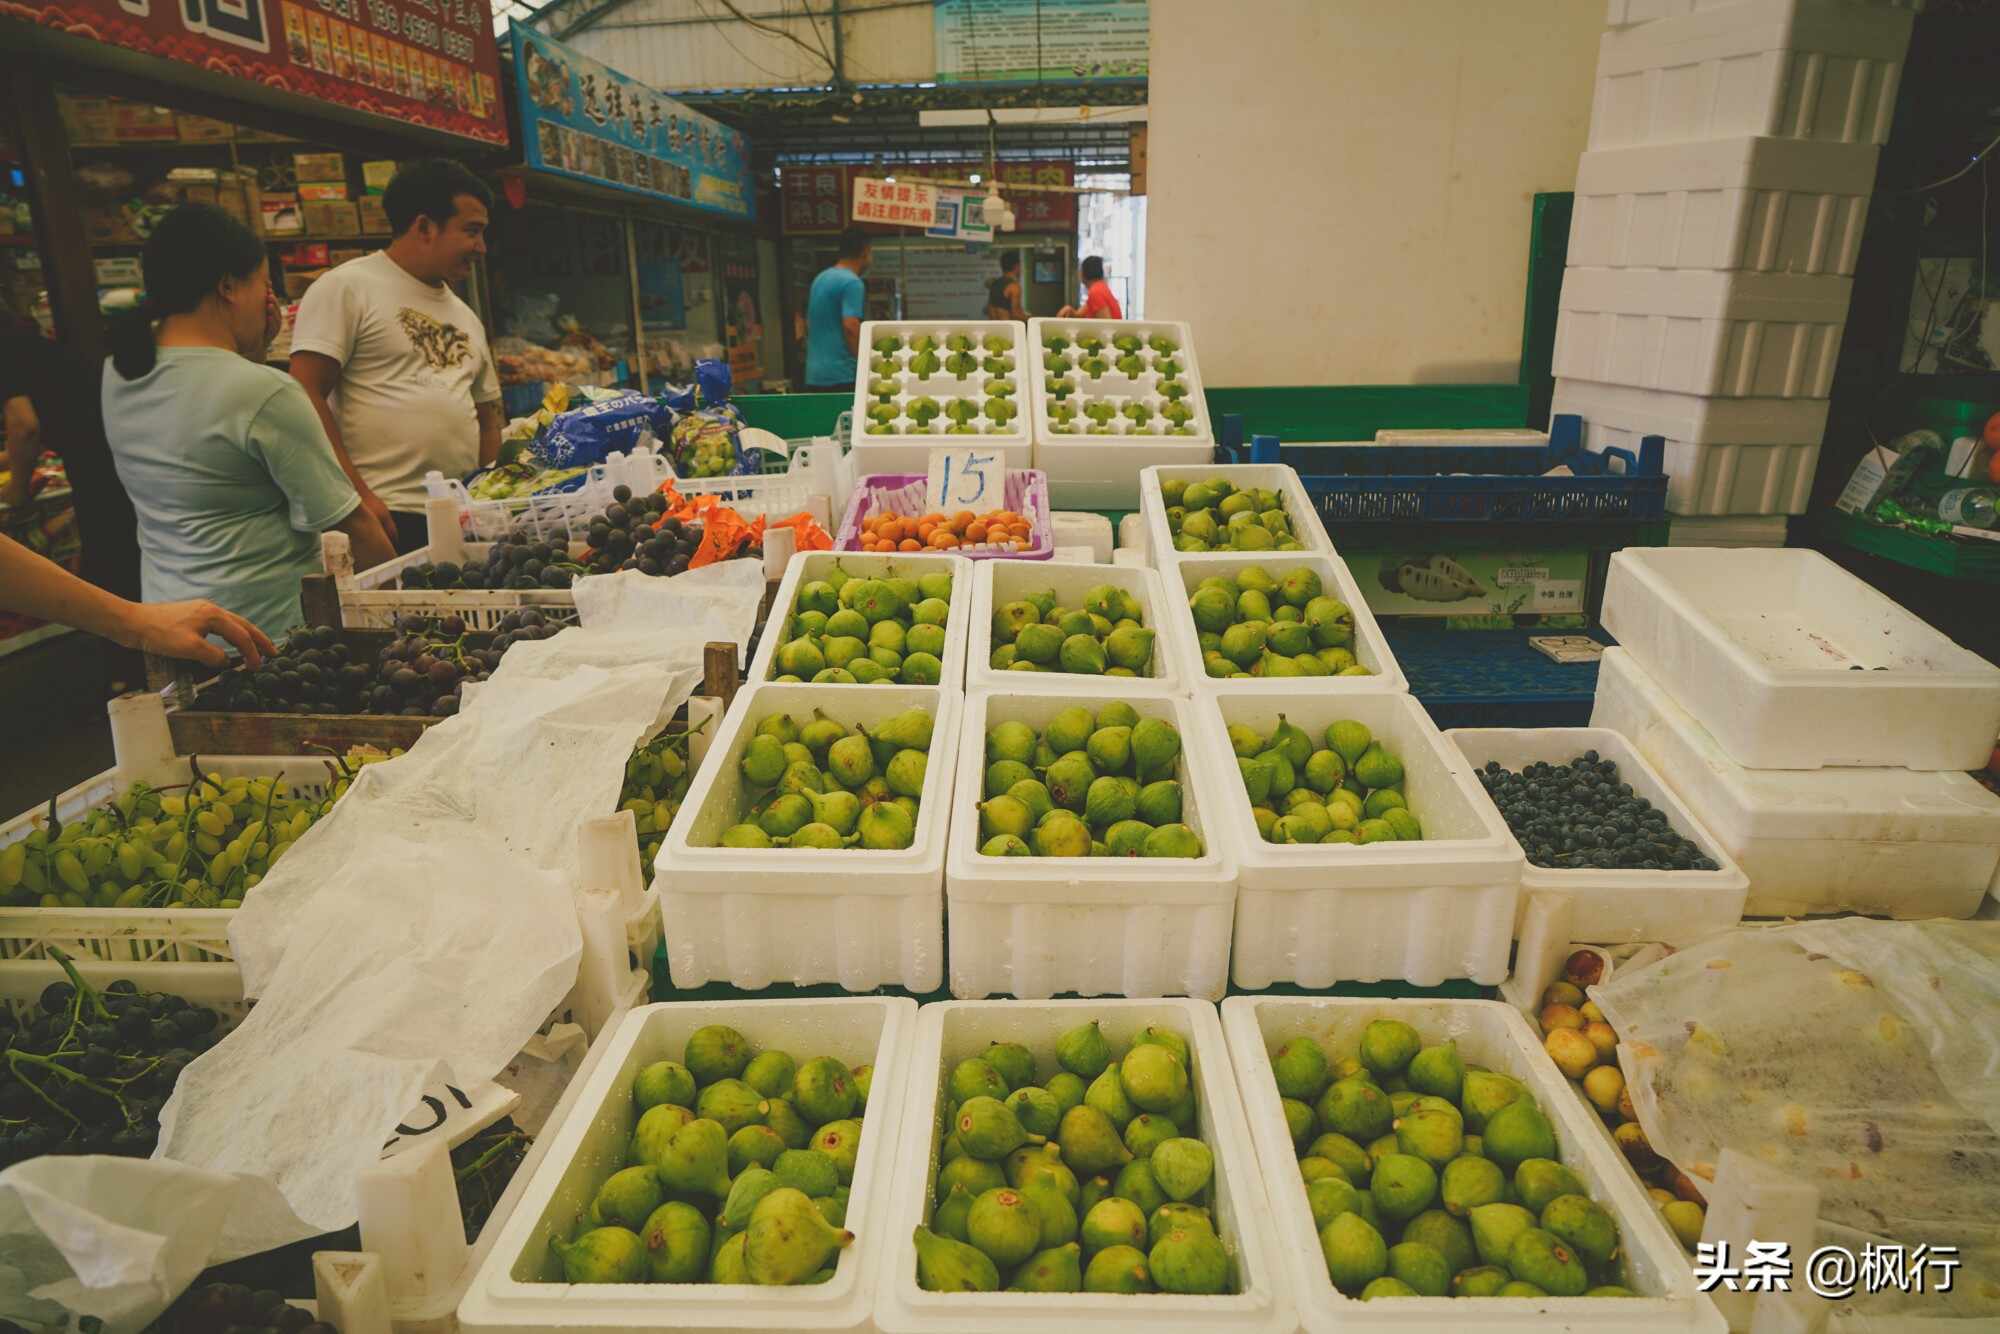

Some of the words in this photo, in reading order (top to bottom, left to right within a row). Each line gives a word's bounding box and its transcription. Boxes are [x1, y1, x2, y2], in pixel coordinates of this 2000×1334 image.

[864, 183, 928, 204] 友情提示
[857, 201, 932, 223] 请注意防滑
[940, 452, 995, 506] 15
